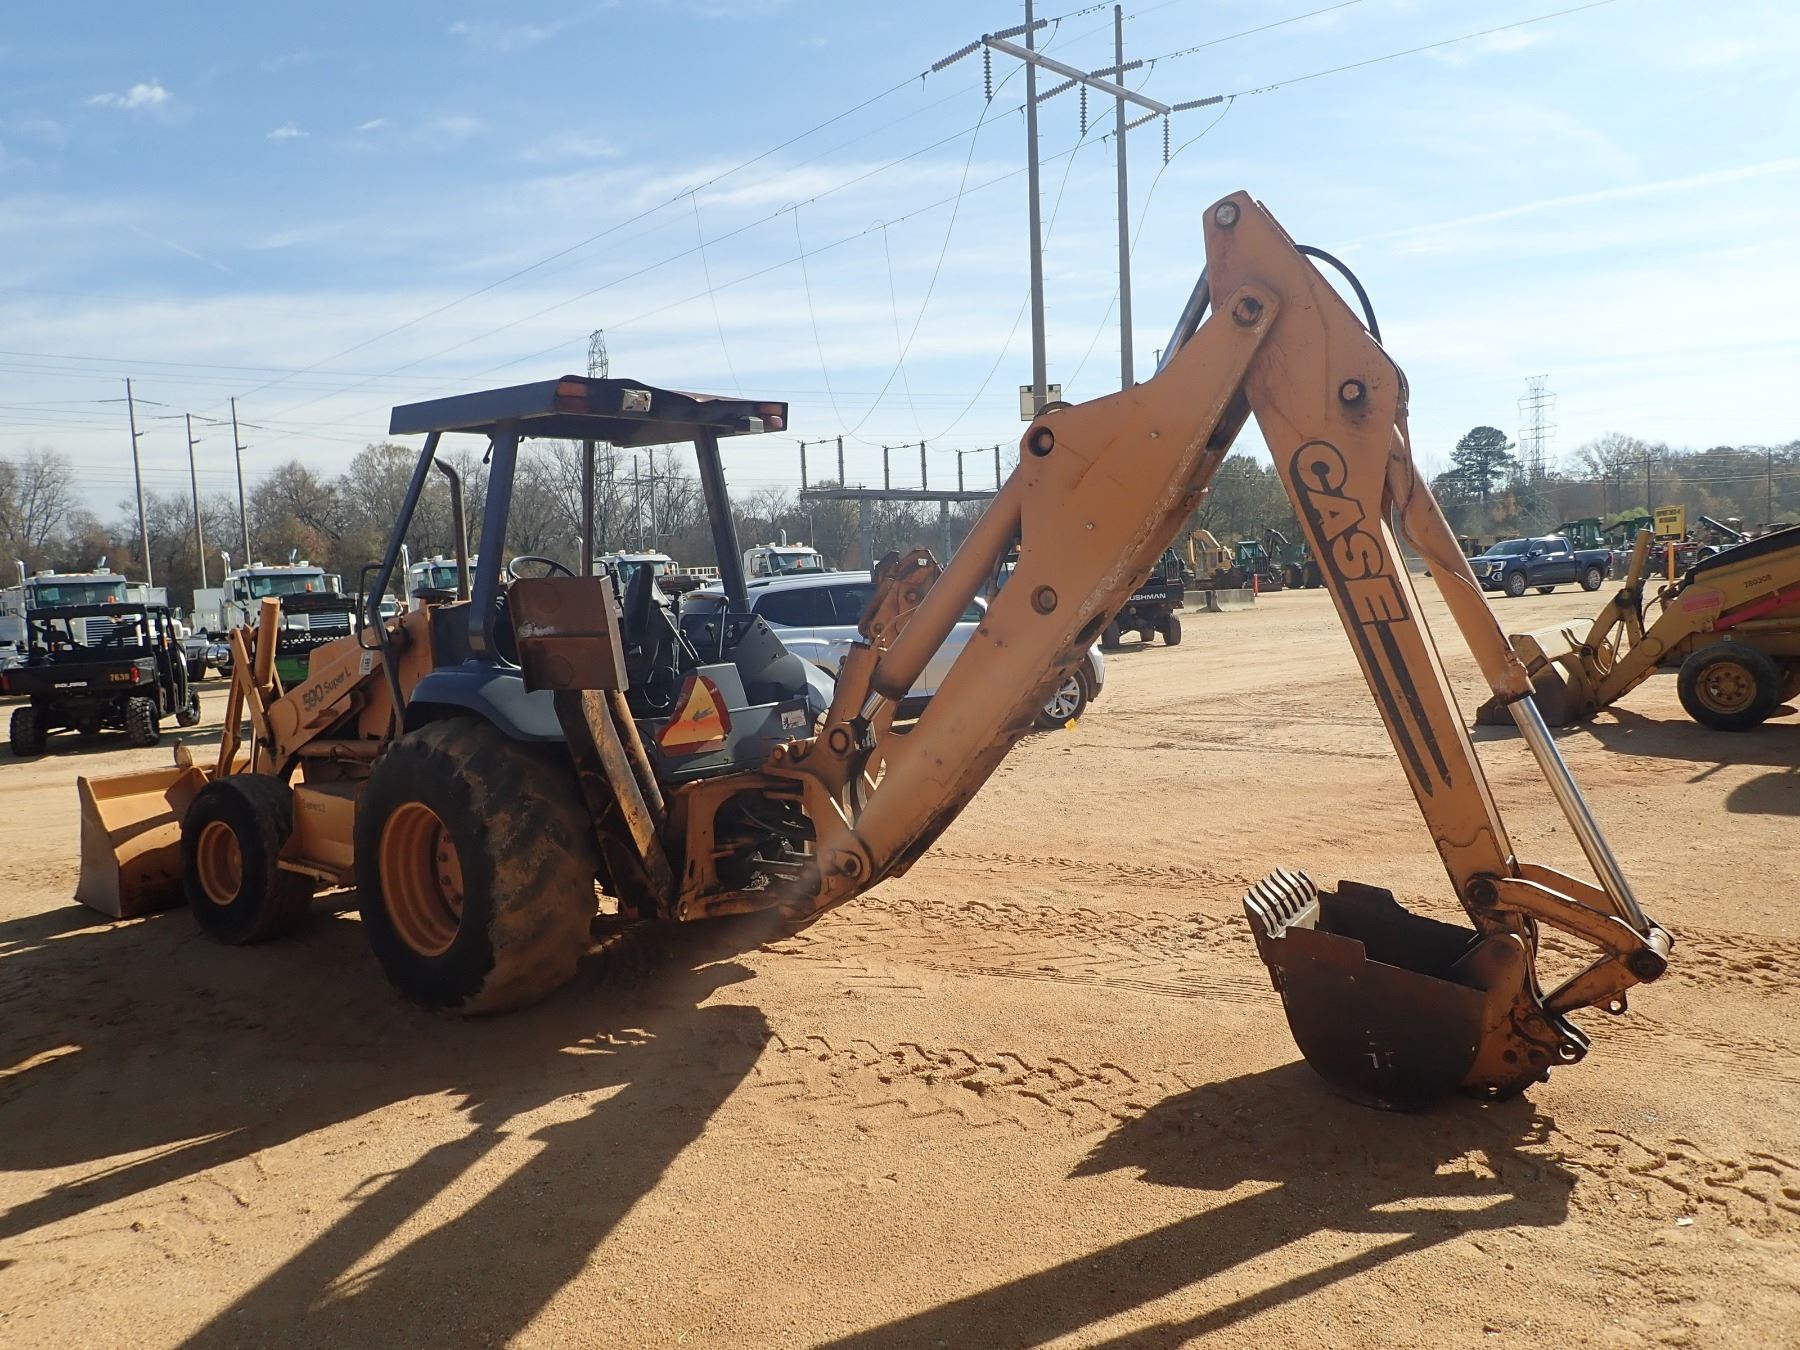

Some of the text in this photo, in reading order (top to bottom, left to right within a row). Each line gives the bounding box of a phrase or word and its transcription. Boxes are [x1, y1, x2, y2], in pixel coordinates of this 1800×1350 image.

[1289, 440, 1409, 626] CASE
[1127, 592, 1166, 601] USHMAN
[323, 671, 345, 693] Super
